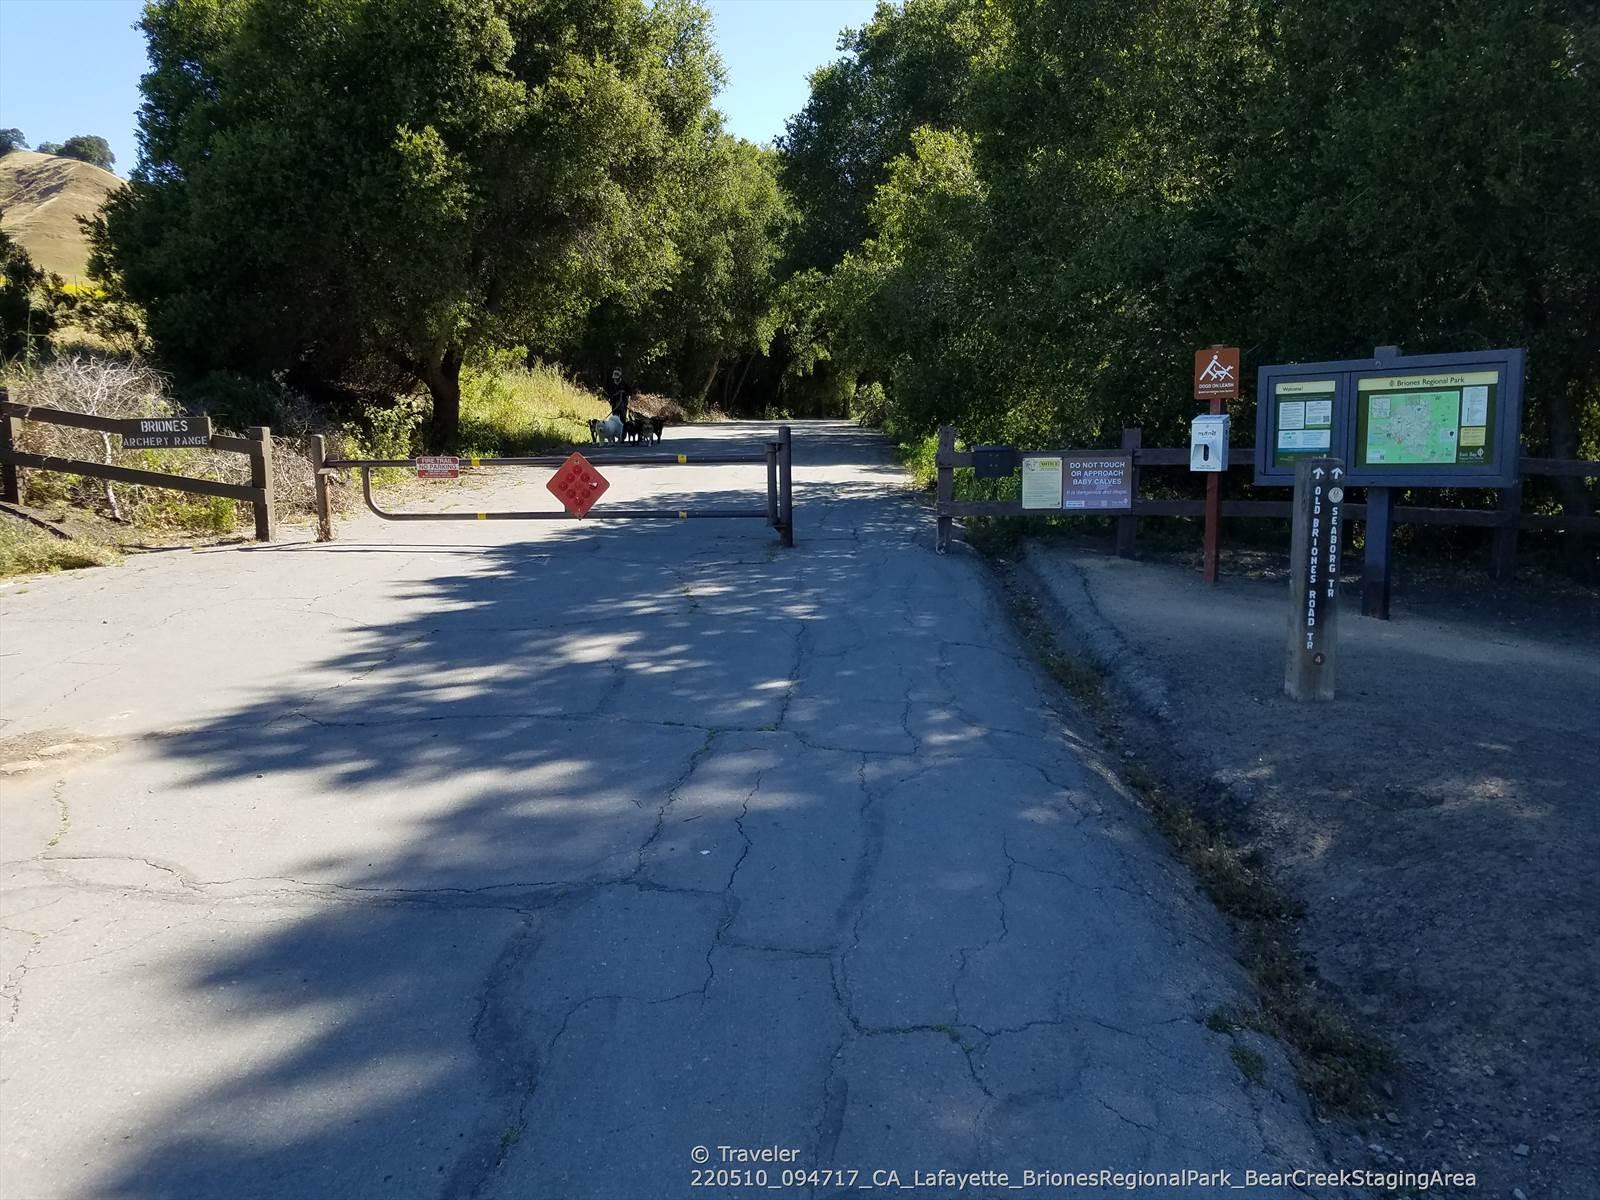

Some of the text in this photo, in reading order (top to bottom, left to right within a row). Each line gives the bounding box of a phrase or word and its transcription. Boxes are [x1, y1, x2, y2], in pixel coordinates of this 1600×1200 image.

[141, 420, 188, 432] BRIONES
[123, 436, 207, 447] ARCHERY RANGE
[1329, 507, 1338, 572] SEABORG
[1310, 518, 1320, 584] BRIONES
[1328, 580, 1334, 598] TR
[1308, 590, 1316, 626] ROAD
[1306, 632, 1314, 650] TR
